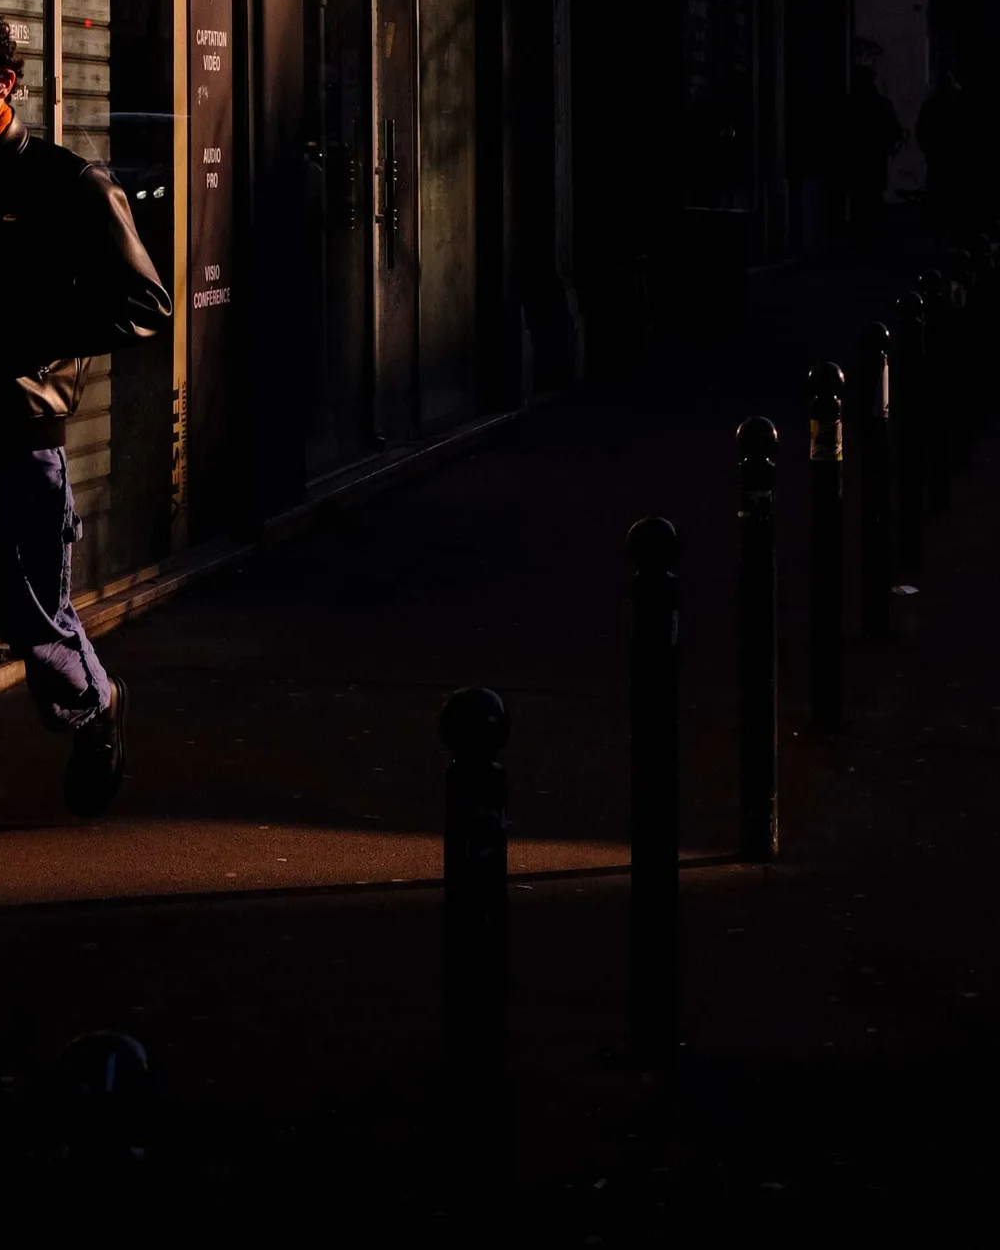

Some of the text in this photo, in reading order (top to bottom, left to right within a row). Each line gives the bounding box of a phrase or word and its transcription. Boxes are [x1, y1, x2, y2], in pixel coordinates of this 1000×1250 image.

[196, 29, 227, 47] CAPTATION
[203, 52, 221, 71] VIDÉO
[203, 148, 221, 164] AUDIO
[206, 172, 218, 188] PRO
[204, 264, 220, 282] VISIO
[194, 286, 230, 309] CONFÉRENCE
